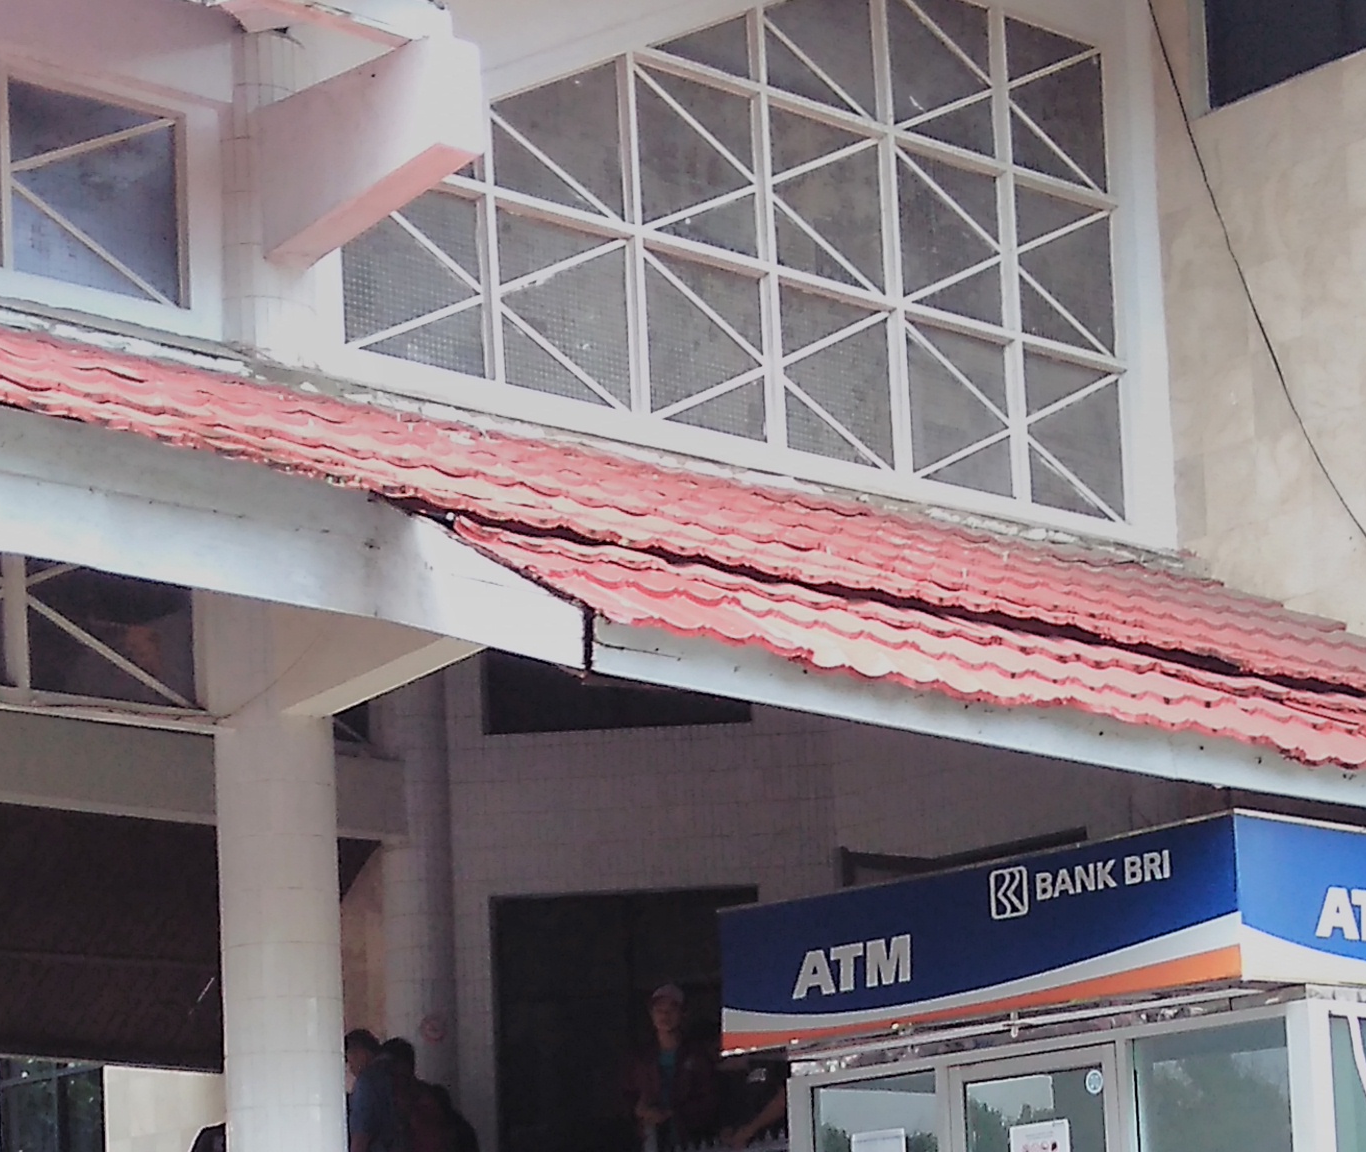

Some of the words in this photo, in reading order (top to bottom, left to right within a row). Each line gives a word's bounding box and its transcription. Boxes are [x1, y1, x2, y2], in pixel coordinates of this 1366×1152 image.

[1035, 859, 1118, 901] BANK
[1124, 850, 1171, 885] BRI
[792, 933, 911, 1000] ATM
